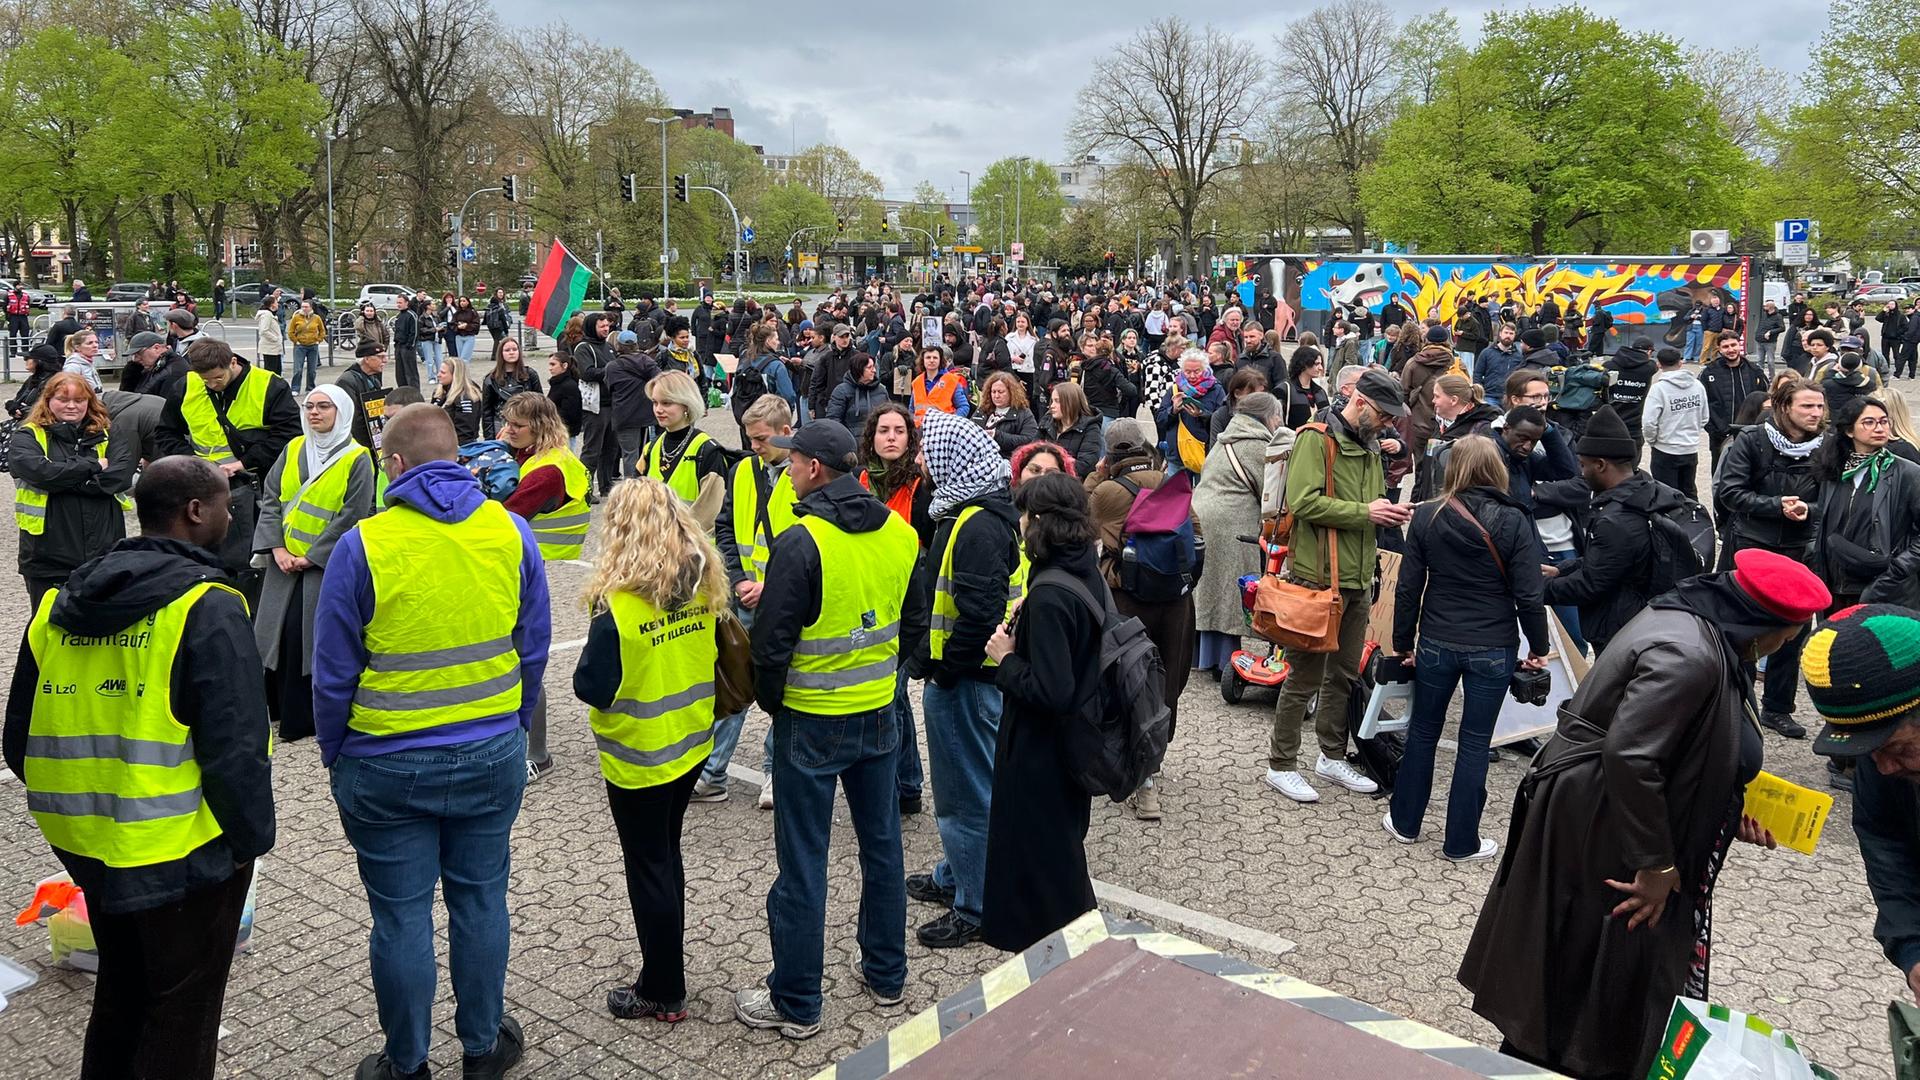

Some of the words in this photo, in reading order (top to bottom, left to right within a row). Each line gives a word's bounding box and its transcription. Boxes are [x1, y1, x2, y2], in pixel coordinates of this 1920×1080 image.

[1789, 222, 1803, 240] P
[1669, 397, 1688, 405] LONG
[639, 618, 664, 635] KEN
[667, 606, 708, 624] MENSCH
[119, 631, 151, 649] auf!
[651, 633, 665, 647] IST
[668, 621, 705, 640] ILLEGAL
